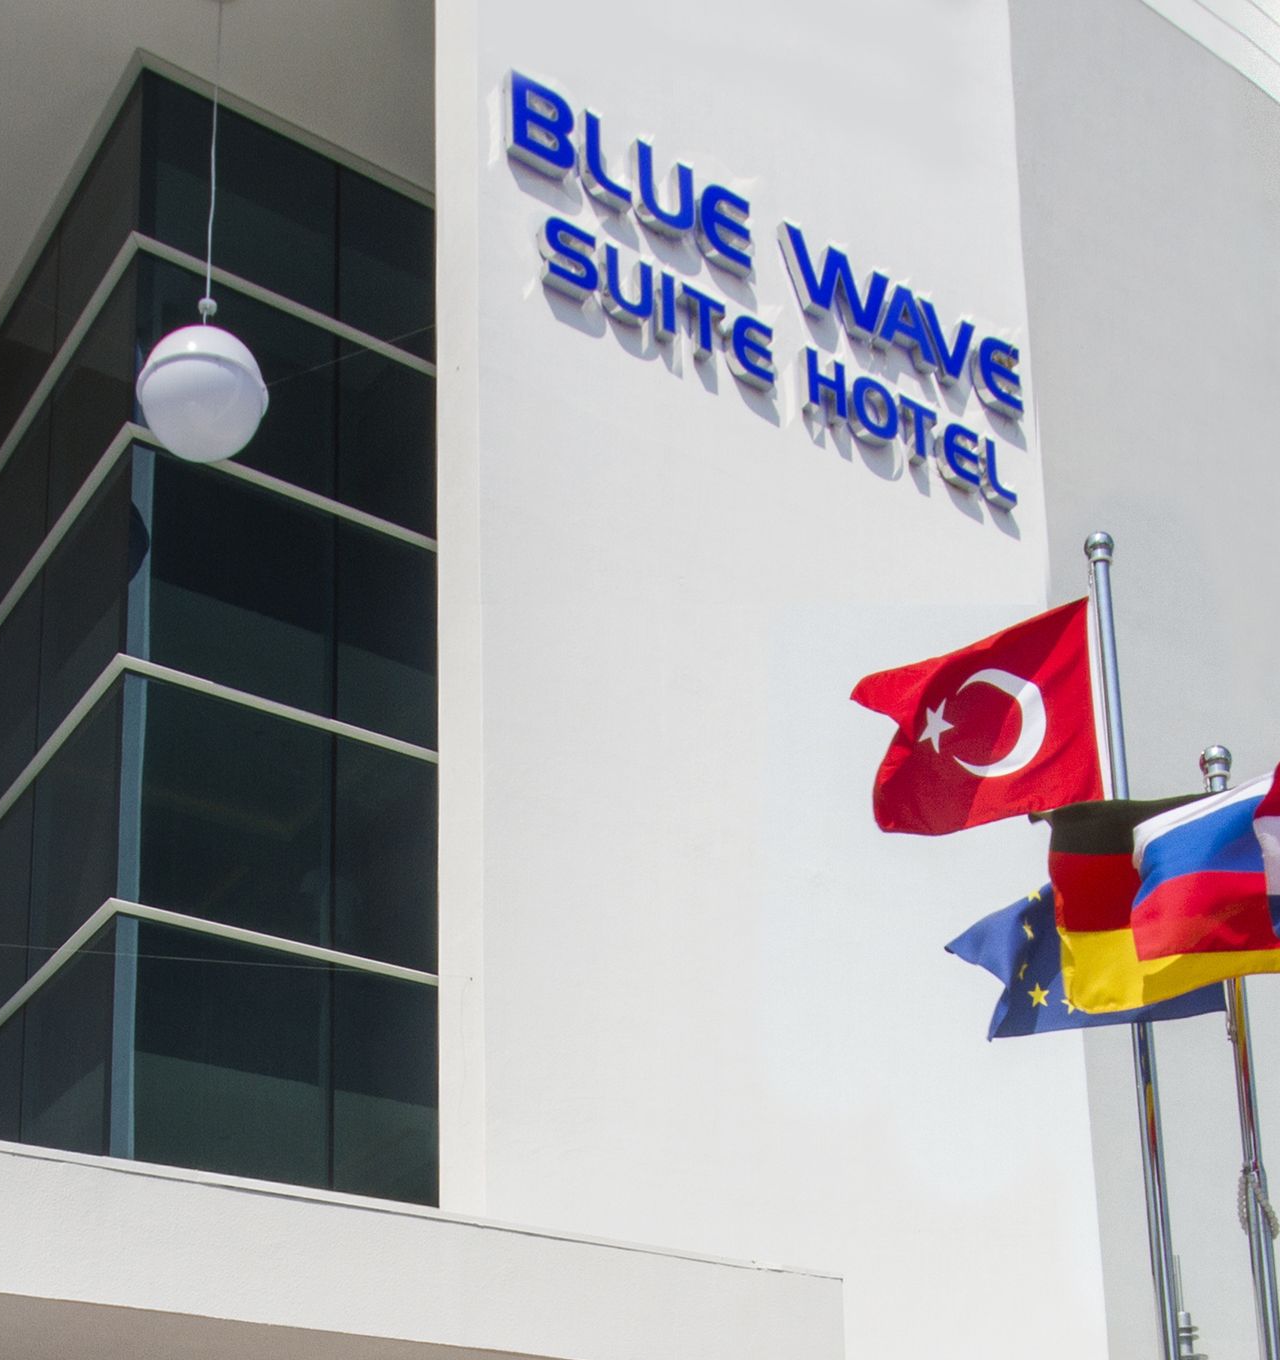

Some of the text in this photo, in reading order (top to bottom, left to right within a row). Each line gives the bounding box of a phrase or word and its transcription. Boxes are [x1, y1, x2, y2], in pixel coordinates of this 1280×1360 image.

[506, 68, 1024, 418] BLUE WAVE
[540, 216, 1018, 511] SUITE HOTEL
